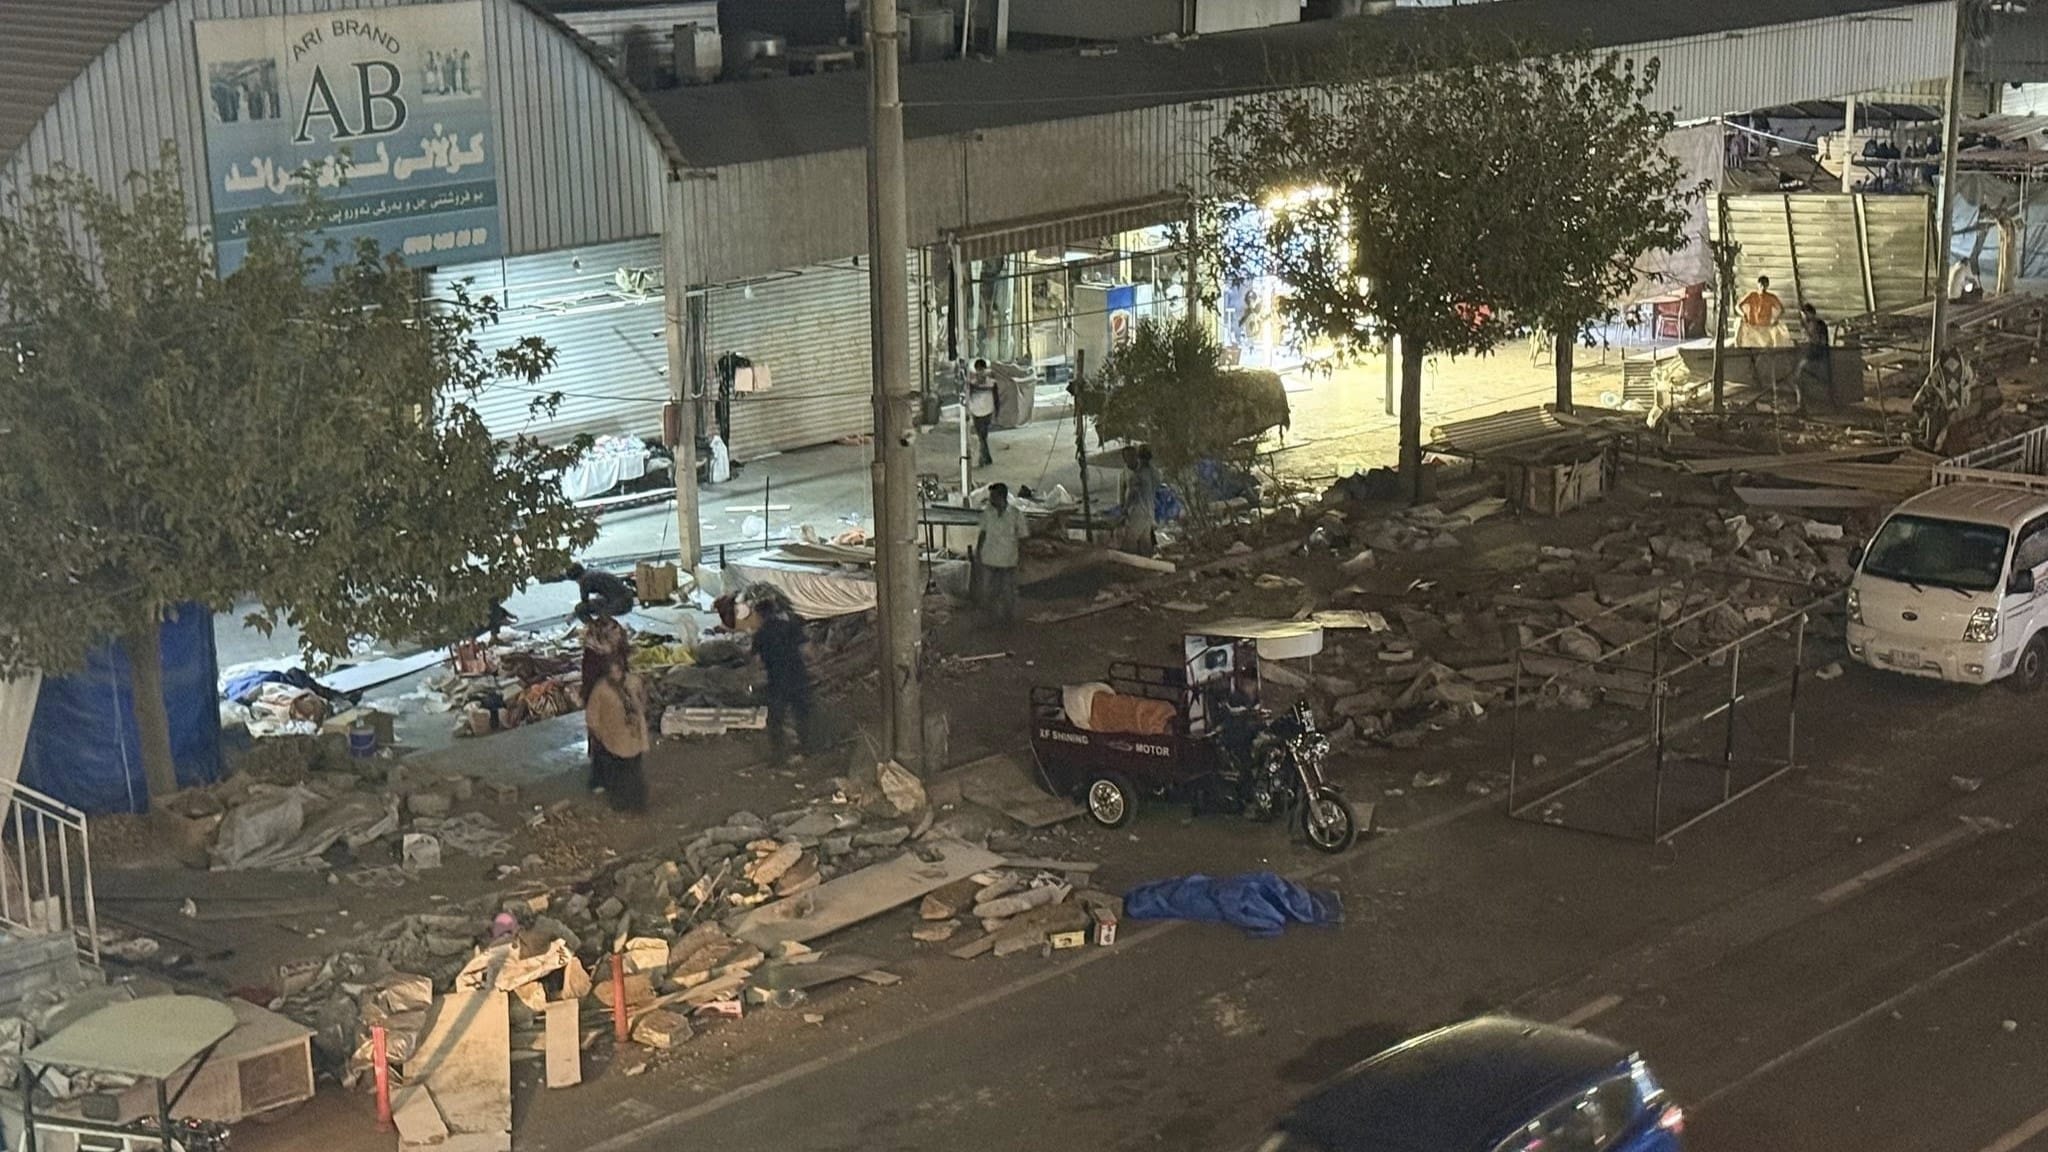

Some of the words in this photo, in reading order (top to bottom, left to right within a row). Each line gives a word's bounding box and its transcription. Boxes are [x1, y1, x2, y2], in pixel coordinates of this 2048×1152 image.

[291, 26, 323, 62] ARI
[332, 19, 401, 55] BRAND
[293, 60, 408, 144] AB
[1136, 743, 1171, 757] MOTOR
